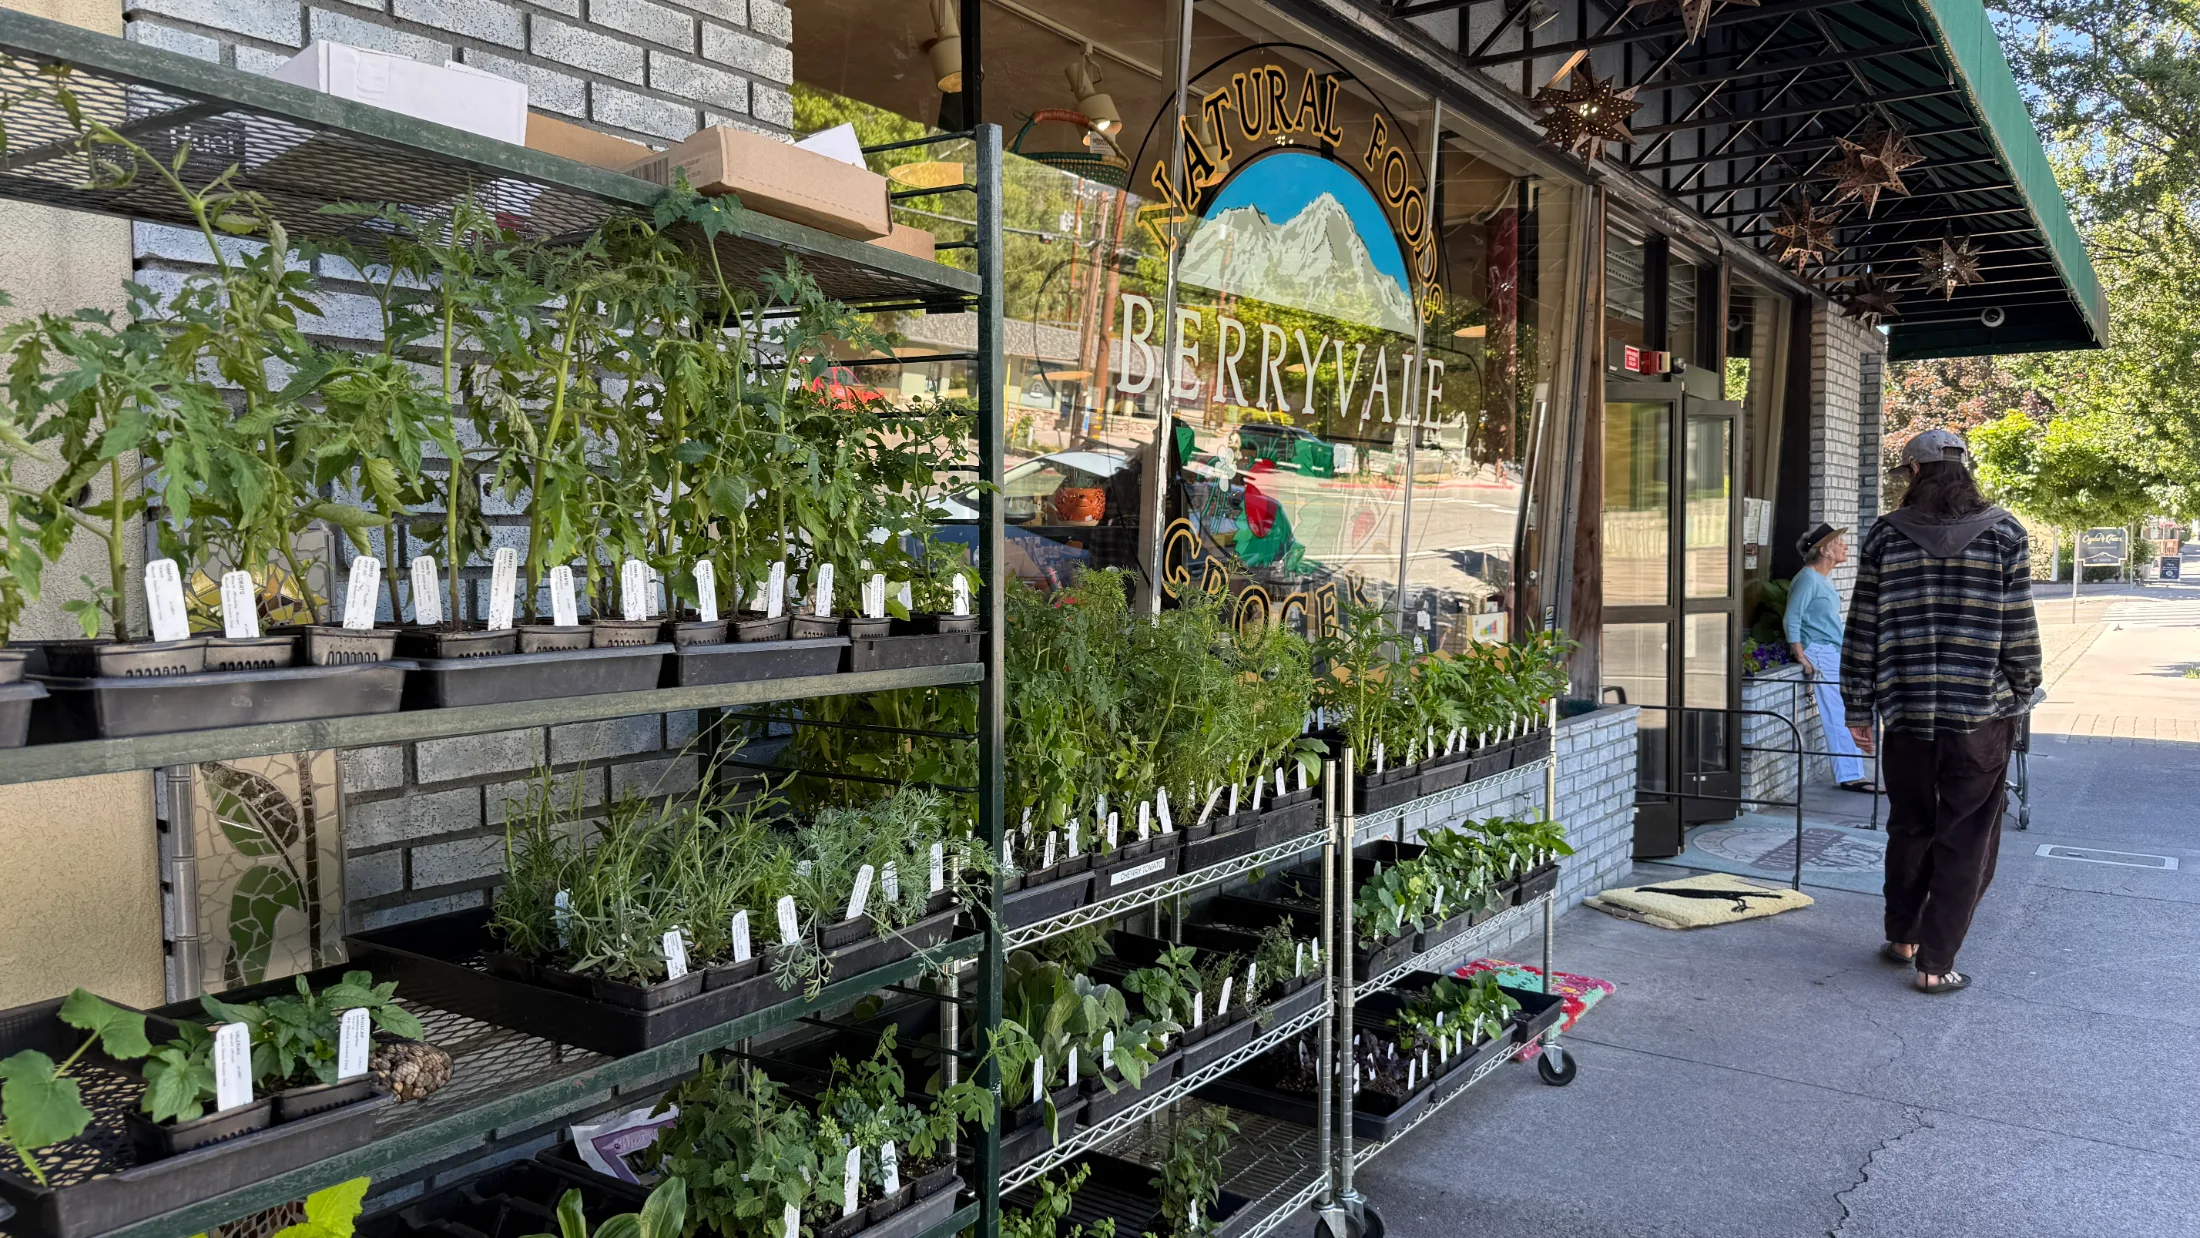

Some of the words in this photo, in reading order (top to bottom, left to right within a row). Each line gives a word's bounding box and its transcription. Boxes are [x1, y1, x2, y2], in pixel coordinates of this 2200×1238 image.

[1136, 64, 1344, 263] NATURAL
[1363, 112, 1445, 324] FOODS
[1116, 292, 1445, 430] BERRYVALE
[237, 574, 245, 595] TOMATO
[1120, 867, 1142, 881] CHERRY
[1142, 860, 1163, 874] TOMATO
